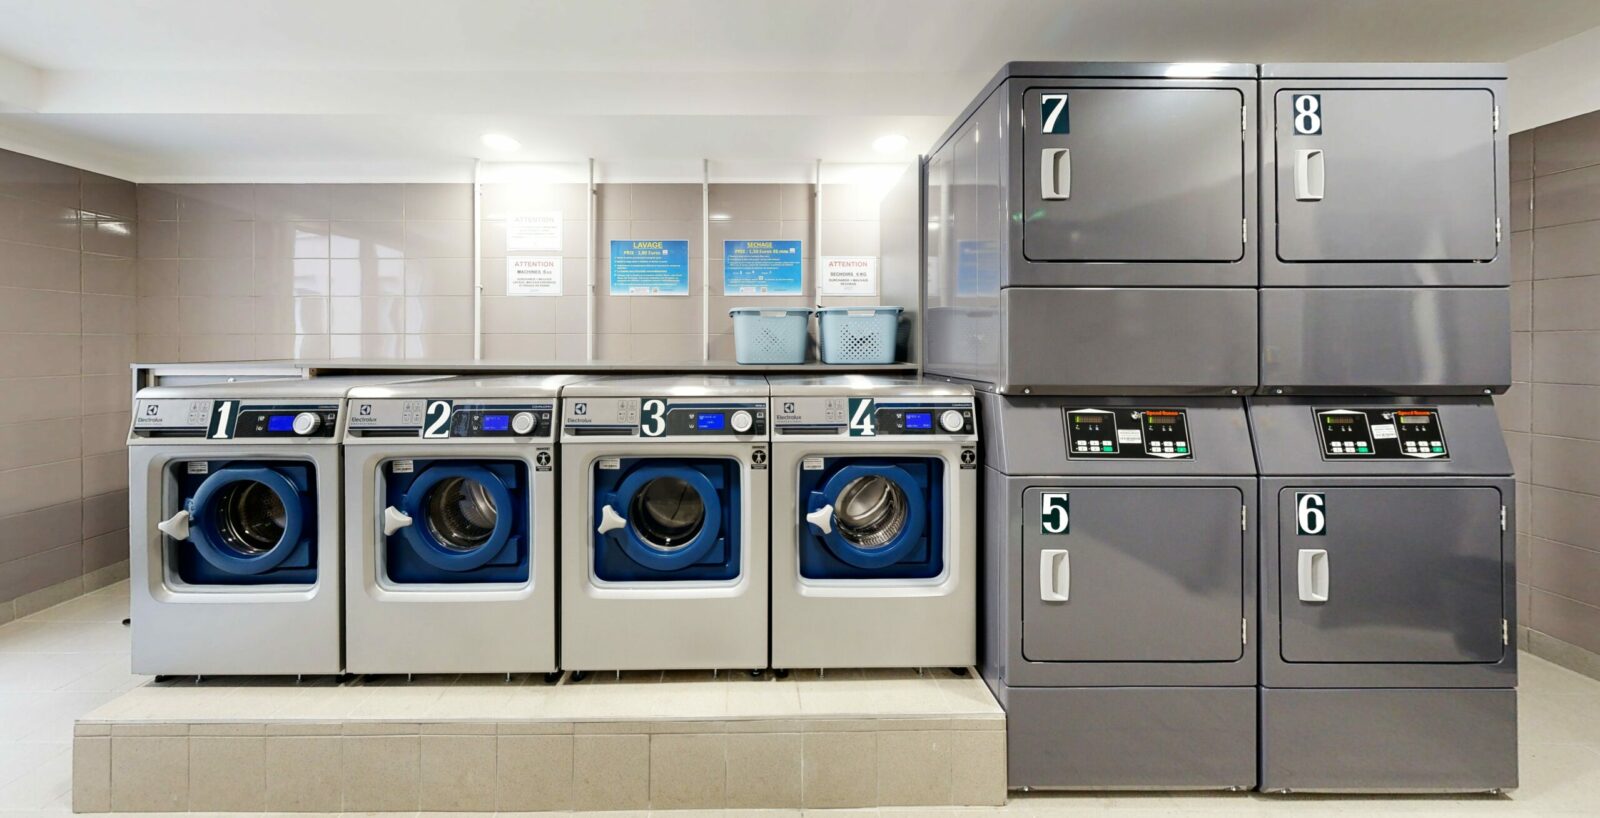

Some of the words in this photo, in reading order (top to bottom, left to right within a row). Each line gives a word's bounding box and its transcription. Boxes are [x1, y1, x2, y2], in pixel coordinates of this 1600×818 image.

[1042, 94, 1068, 132] 7
[1295, 95, 1320, 134] 8
[633, 241, 663, 249] LAVAGE
[212, 401, 232, 438] 1
[423, 401, 451, 438] 2
[641, 399, 666, 437] 3
[850, 399, 875, 436] 4
[1043, 494, 1069, 533] 5
[1298, 494, 1325, 534] 6
